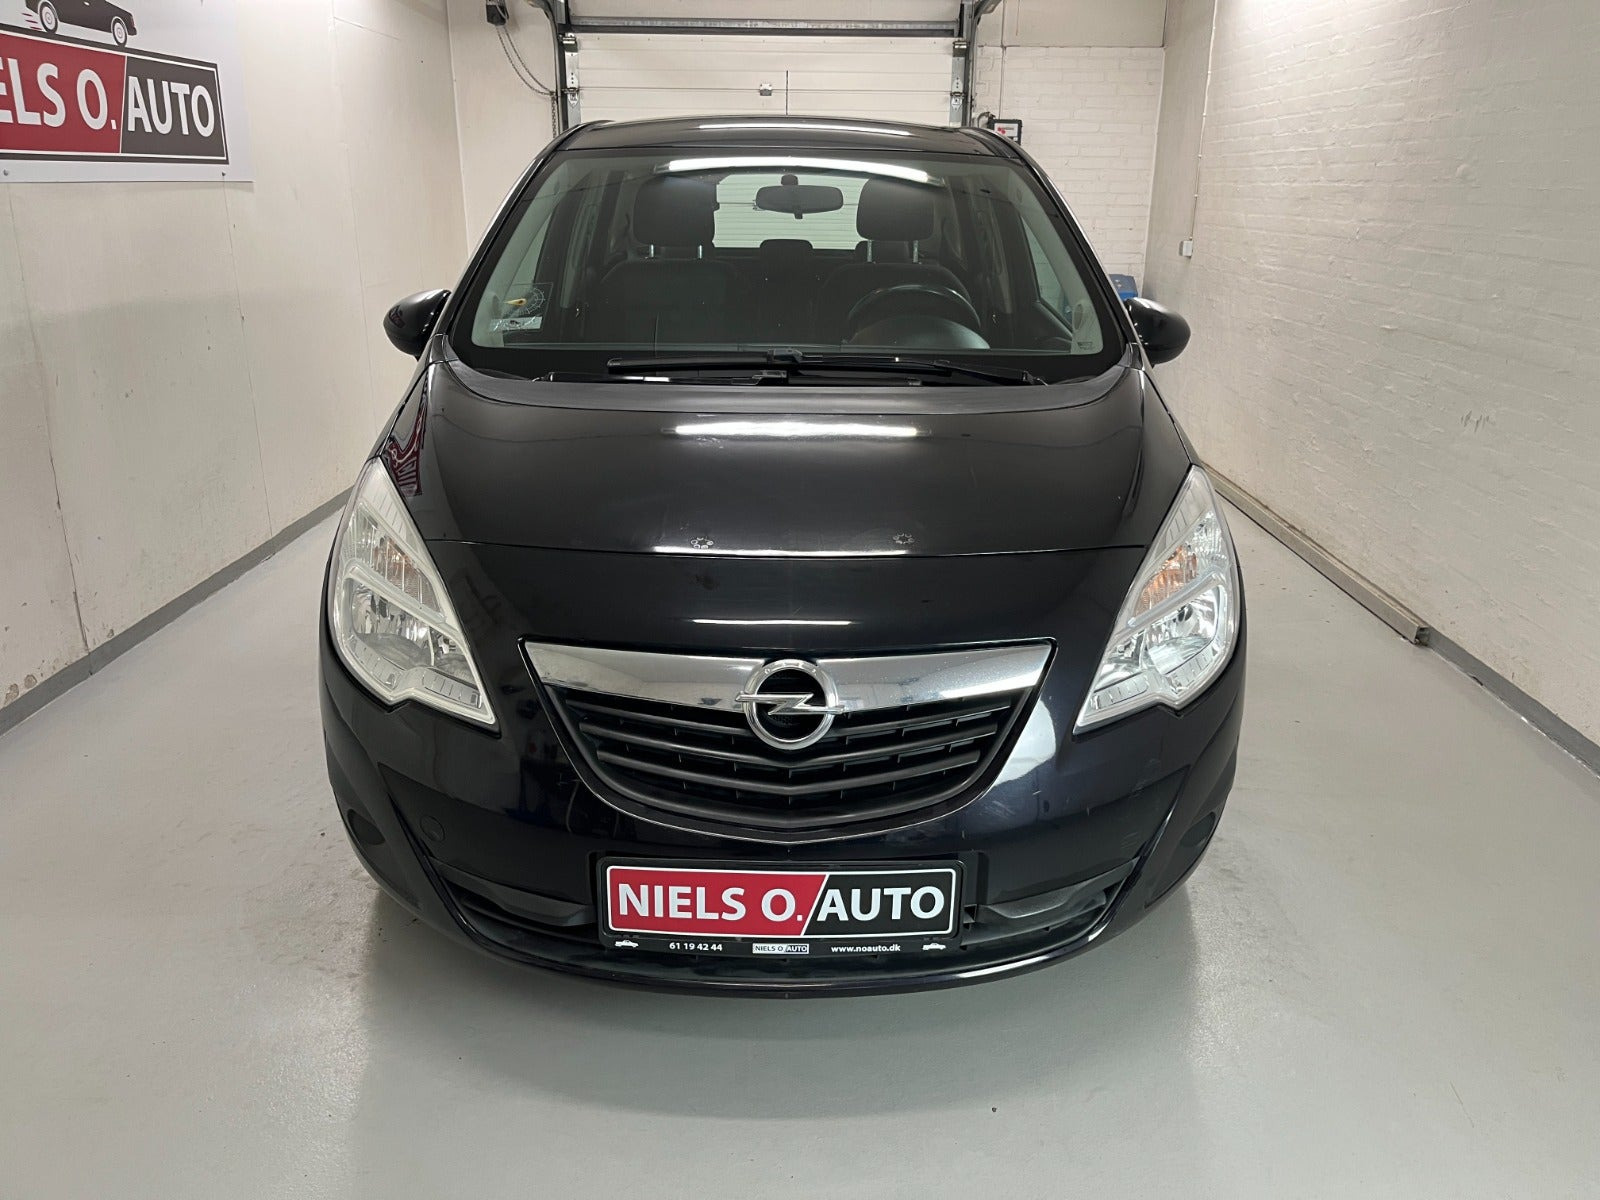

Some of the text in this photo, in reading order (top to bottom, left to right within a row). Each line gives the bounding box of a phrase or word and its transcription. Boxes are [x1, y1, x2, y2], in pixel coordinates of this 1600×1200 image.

[76, 68, 117, 130] O.
[127, 75, 215, 138] AUTO
[618, 883, 945, 922] NIELS O. AUTO
[669, 942, 723, 951] 61 19 42 44
[754, 944, 776, 952] NIELS
[831, 943, 901, 953] www.noauto.dk
